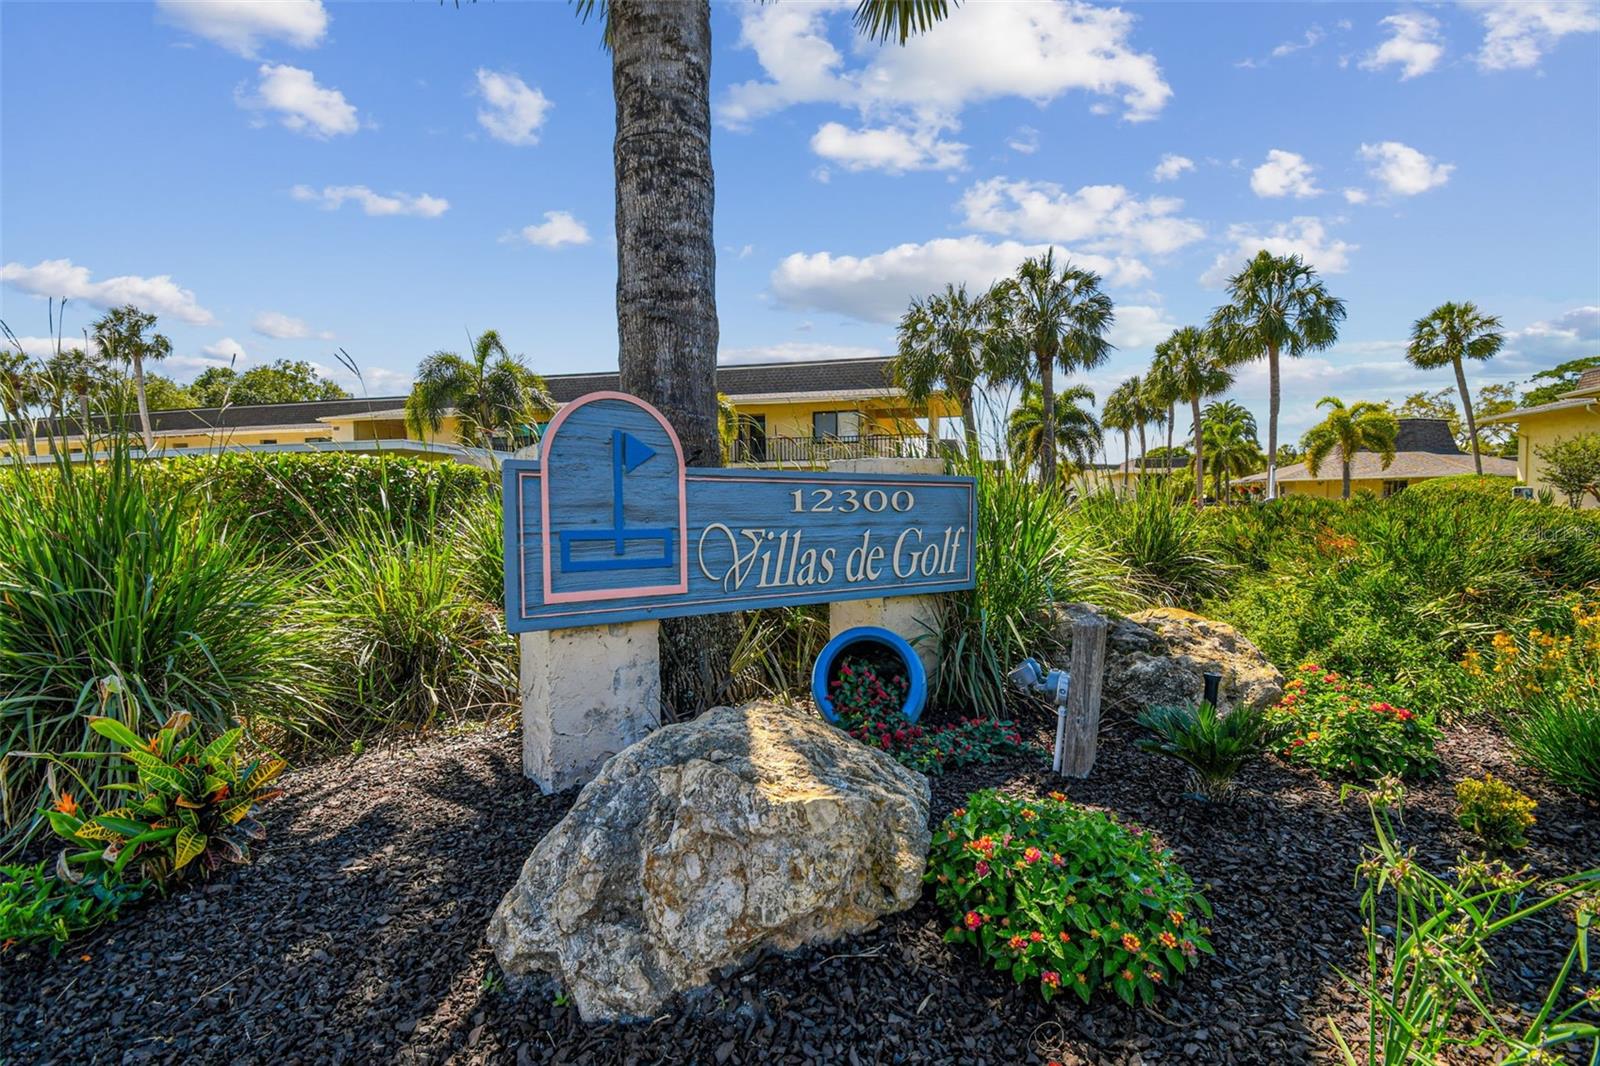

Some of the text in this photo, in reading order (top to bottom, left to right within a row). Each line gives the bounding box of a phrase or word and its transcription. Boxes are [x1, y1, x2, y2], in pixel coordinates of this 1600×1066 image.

[789, 488, 915, 513] 12300
[698, 522, 965, 593] Villas de Golf
